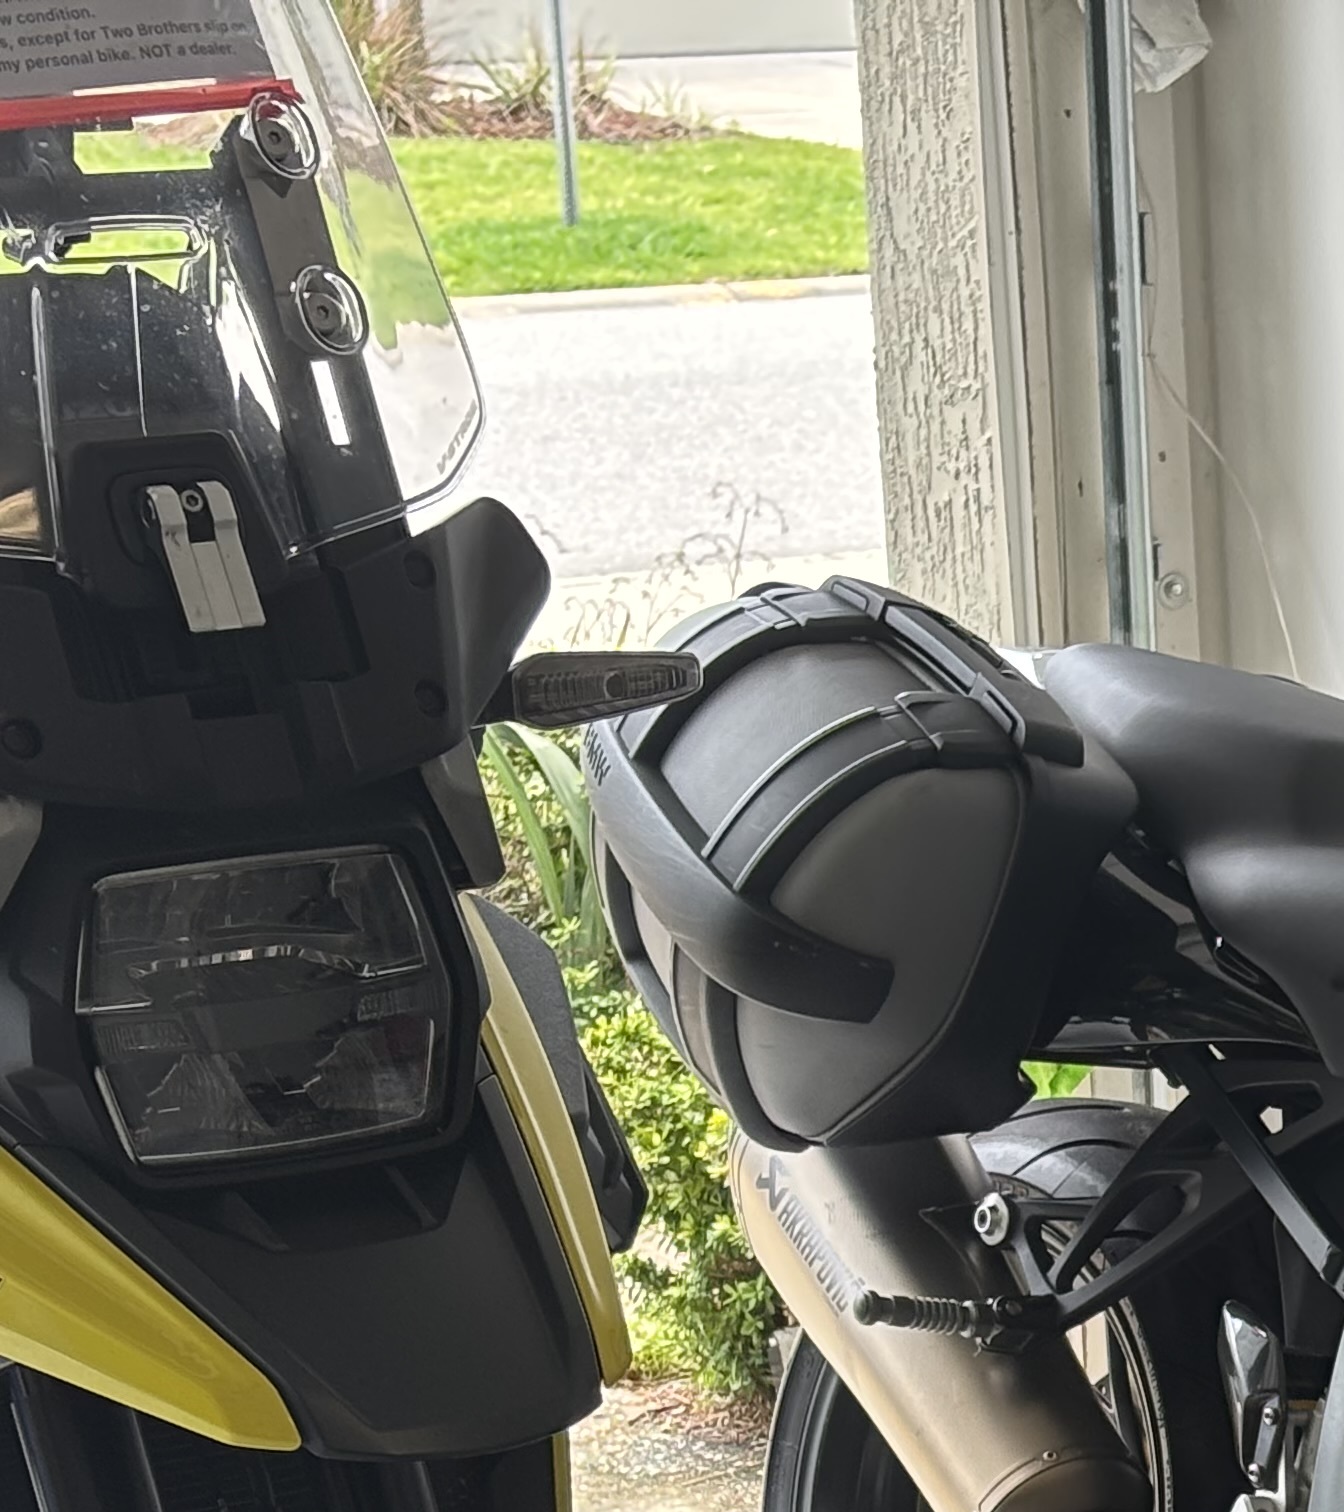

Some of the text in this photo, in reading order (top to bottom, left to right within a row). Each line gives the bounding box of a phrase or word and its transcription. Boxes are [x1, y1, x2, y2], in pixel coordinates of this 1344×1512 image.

[17, 7, 95, 25] condition.
[18, 29, 70, 48] except
[74, 27, 96, 42] for
[100, 25, 133, 41] Two
[138, 21, 200, 37] Brothers
[203, 20, 228, 35] slip
[26, 52, 94, 73] personal
[98, 48, 136, 63] bike.
[139, 43, 173, 60] NOT
[177, 46, 187, 57] a
[189, 41, 237, 57] dealer.
